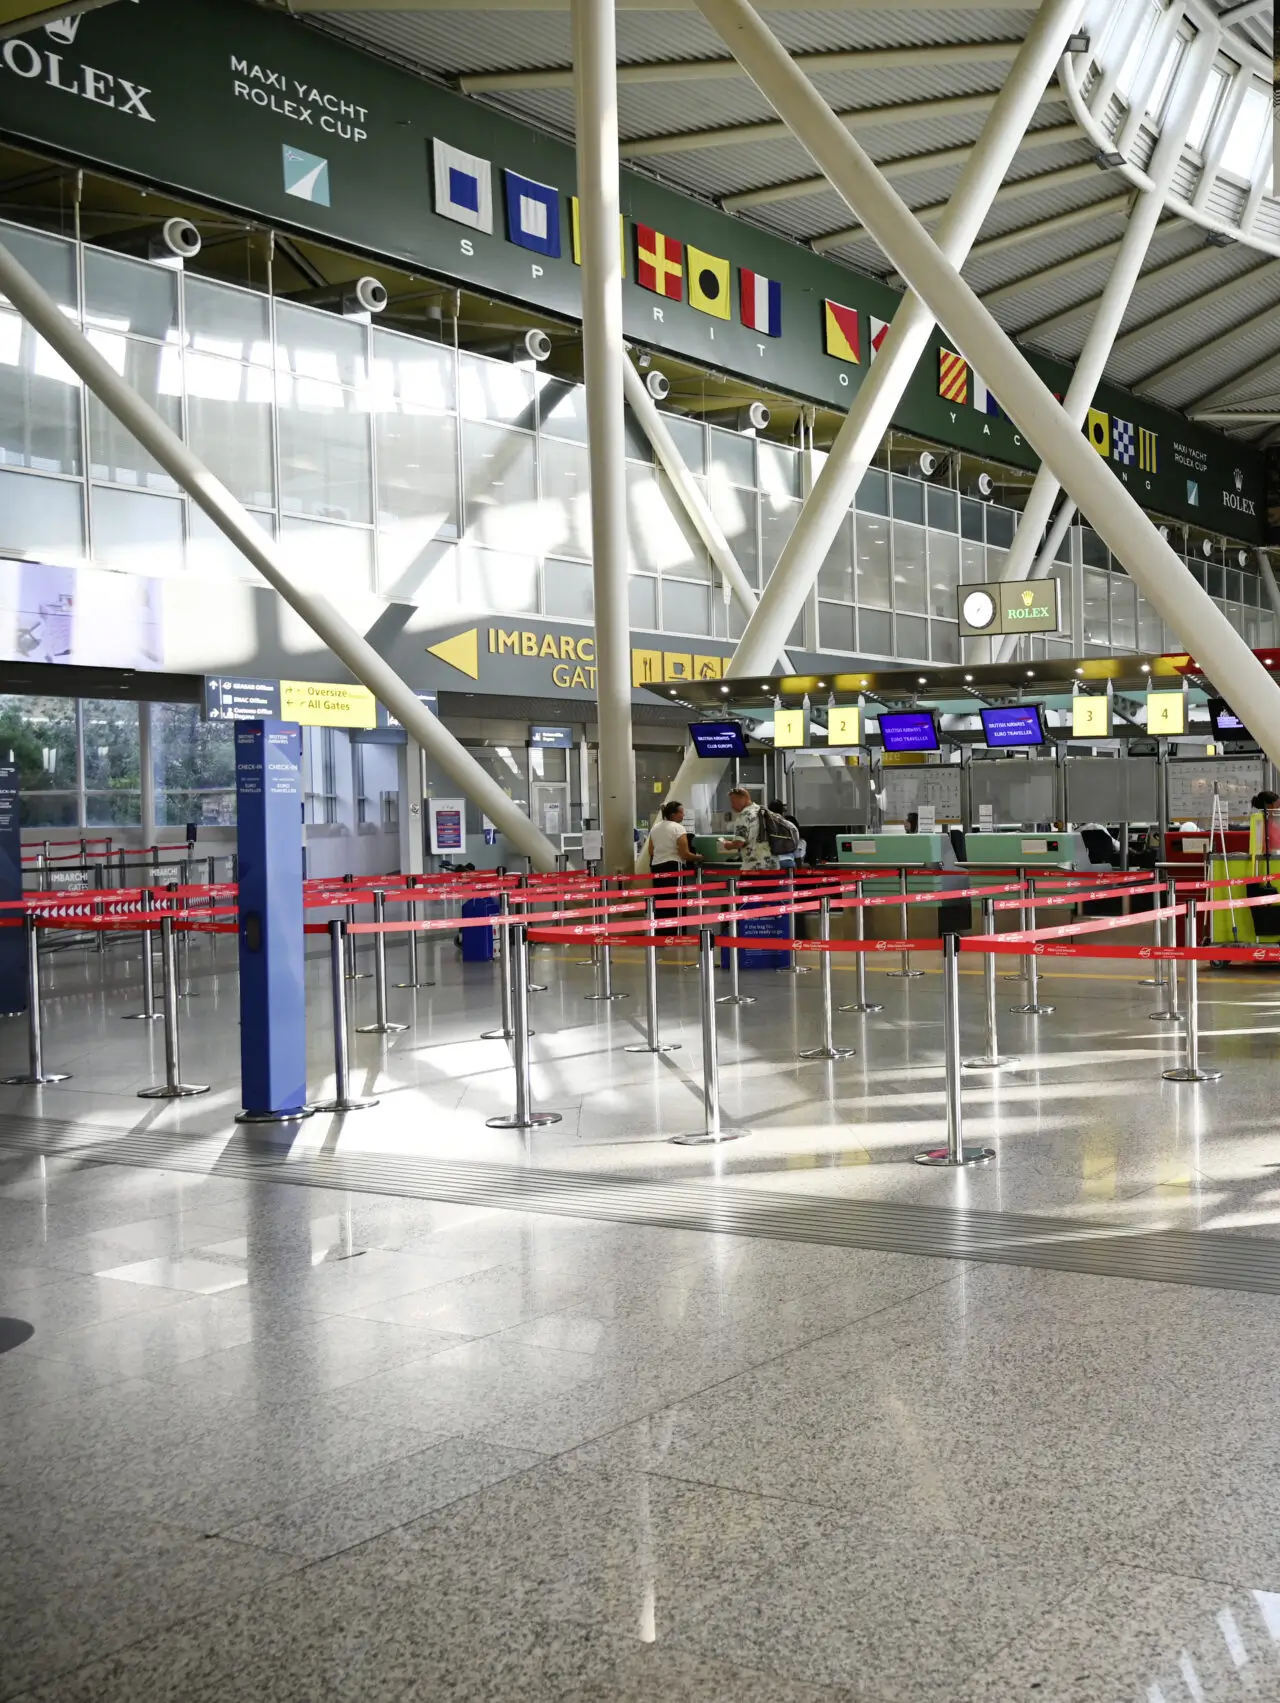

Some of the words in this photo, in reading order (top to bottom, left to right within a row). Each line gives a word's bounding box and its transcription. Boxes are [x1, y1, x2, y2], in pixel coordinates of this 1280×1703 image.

[0, 38, 156, 122] OLEX
[230, 54, 286, 91] MAXI
[294, 80, 368, 122] YACHT
[234, 80, 314, 125] ROLEX
[320, 115, 367, 142] CUP
[460, 239, 474, 256] S
[531, 264, 544, 279] P
[653, 307, 664, 323] R
[756, 344, 766, 357] T
[839, 373, 849, 386] O
[950, 412, 957, 424] Y
[983, 423, 990, 435] A
[1013, 434, 1021, 446] C
[1173, 442, 1188, 453] MAXI
[1188, 448, 1208, 461] YACHT
[1174, 453, 1194, 467] ROLEX
[1195, 461, 1208, 472] CUP
[1222, 490, 1256, 516] ROLEX
[1007, 606, 1050, 620] ROLEX
[308, 687, 348, 698] Oversize
[324, 701, 350, 712] Gates
[1086, 710, 1093, 723] 3
[1161, 707, 1168, 721] 4
[787, 723, 791, 734] 1
[840, 720, 847, 732] 2
[51, 872, 88, 882] IMBARCHI
